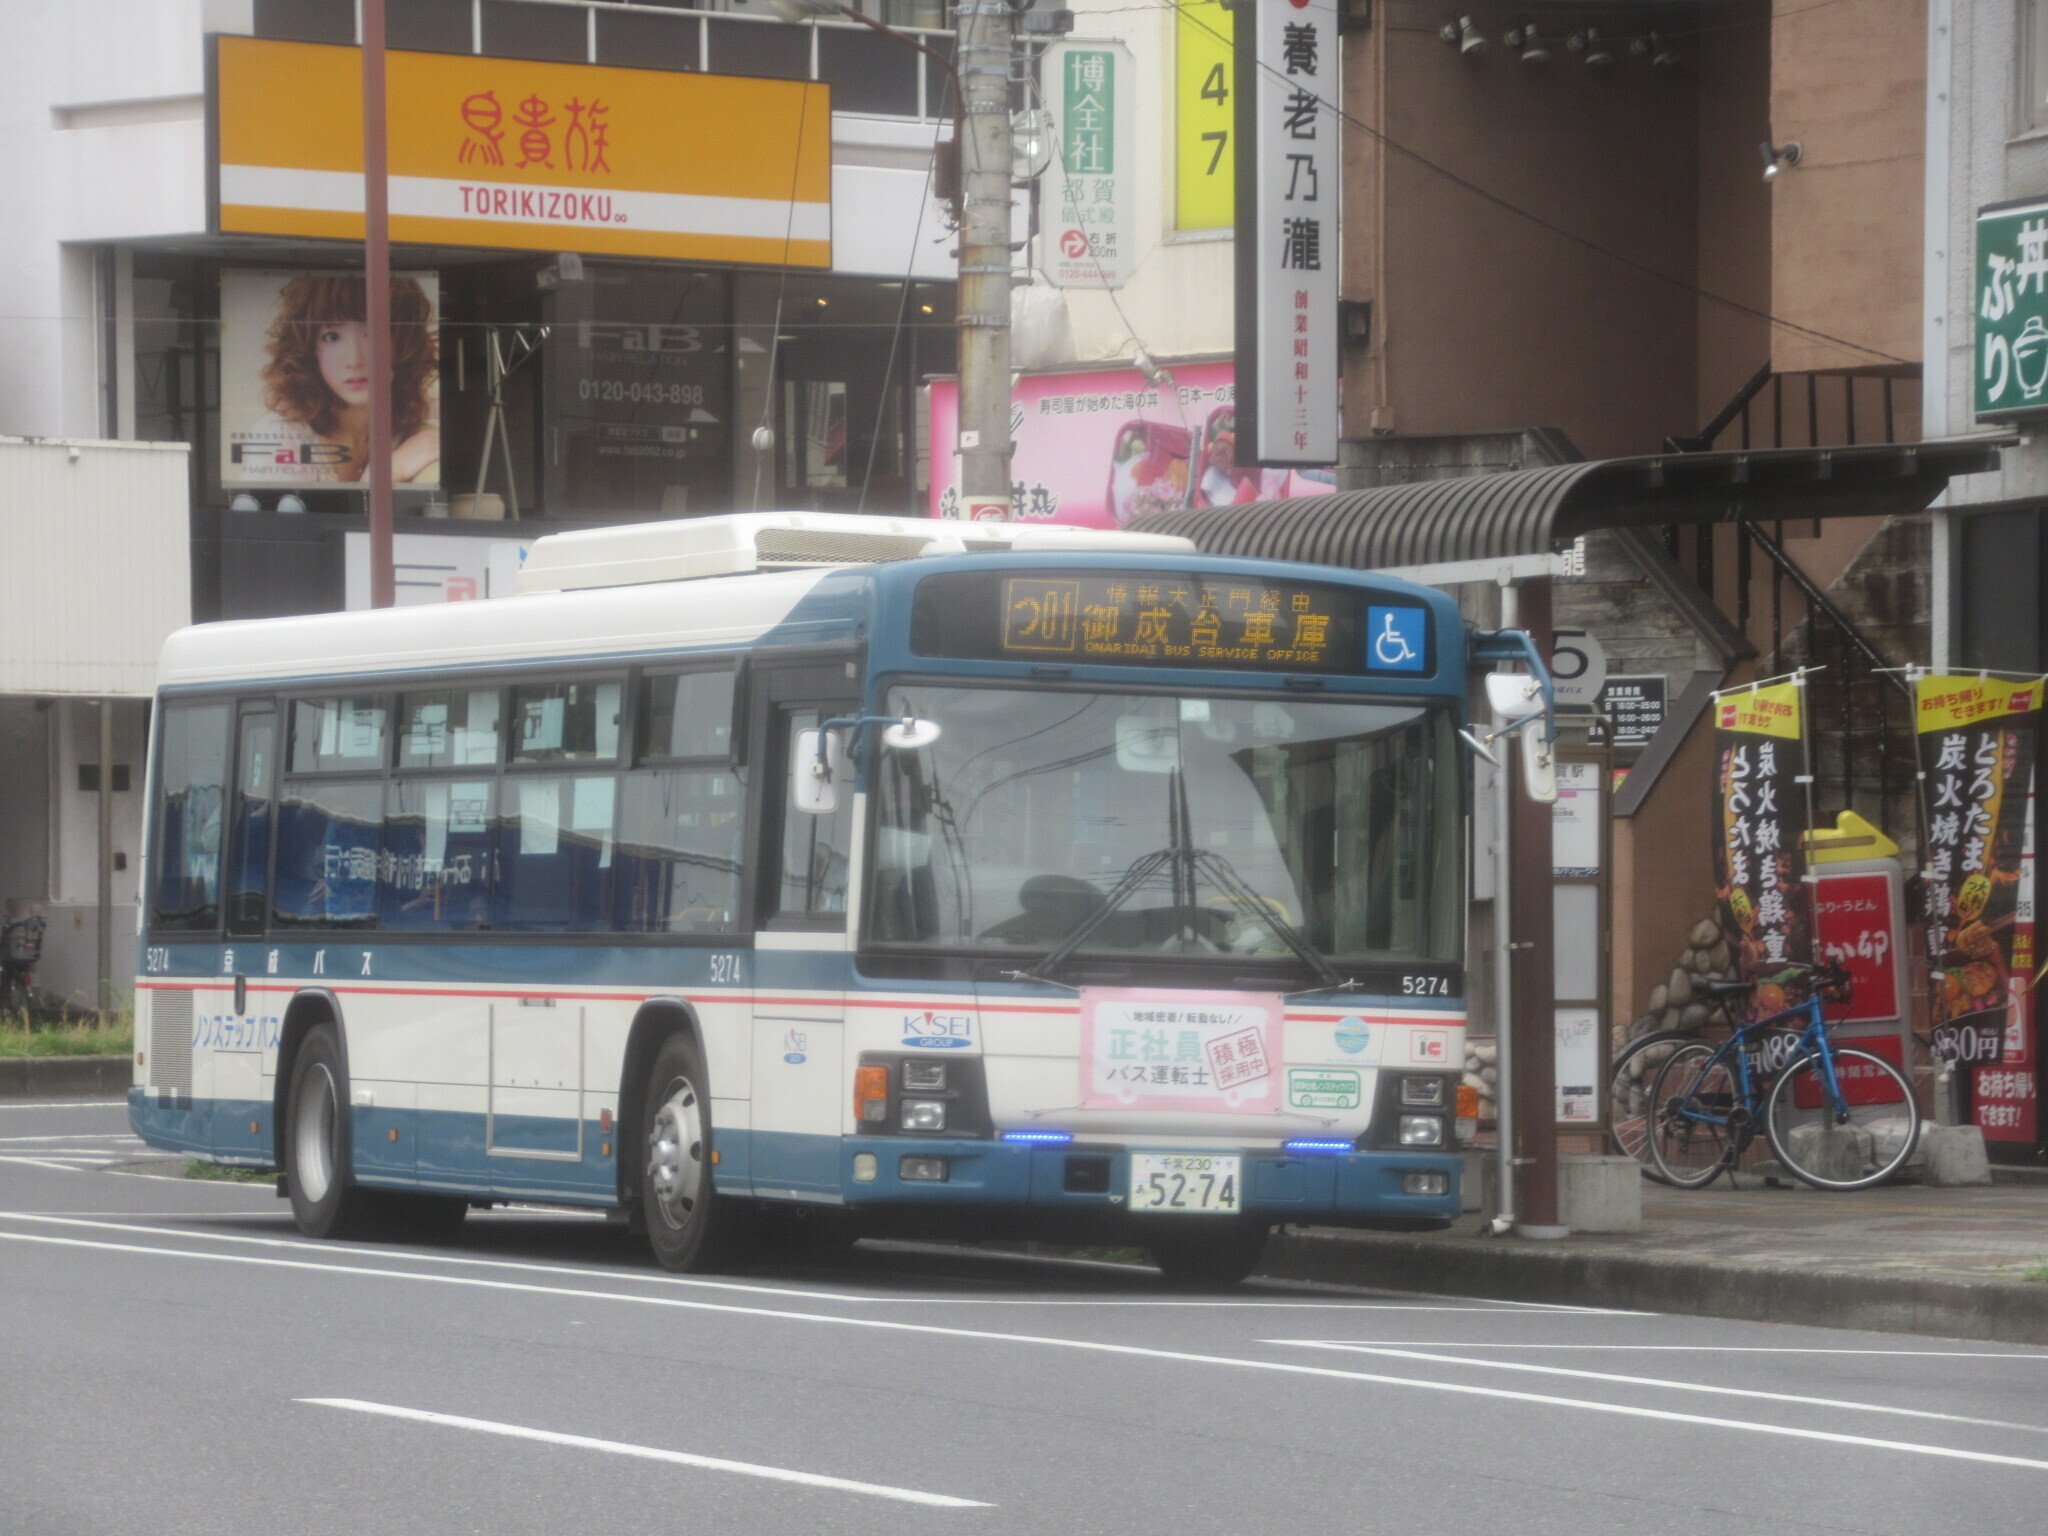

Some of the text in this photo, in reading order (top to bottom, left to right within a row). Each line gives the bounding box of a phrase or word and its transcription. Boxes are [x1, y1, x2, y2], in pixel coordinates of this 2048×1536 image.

[1070, 55, 1106, 171] 博全社
[458, 91, 611, 174] 鳥貴族
[1281, 21, 1322, 271] 養老乃瀧
[459, 186, 611, 222] TORIKIZOKU
[1061, 179, 1115, 204] 都賀
[1089, 232, 1117, 245] 右折
[578, 320, 703, 353] FaB
[1294, 289, 1309, 450] 創業昭和十三年
[578, 378, 704, 405] 0120-043-898
[1040, 393, 1158, 415] 寿司屋が始めた海の丼
[231, 443, 353, 465] FaB
[1082, 603, 1330, 648] 御成台車庫
[1164, 645, 1191, 658] BUS
[1920, 687, 1984, 712] お持ち帰り
[1949, 698, 2004, 720] できます!
[1961, 732, 1998, 872] とろたま
[146, 948, 170, 972] 5274
[223, 949, 373, 976] 京成バス
[1812, 930, 1889, 968] か卯
[710, 954, 741, 983] 5274
[1402, 976, 1449, 996] 5274
[193, 1015, 281, 1048] ノンステップバス
[920, 1038, 953, 1048] GROUP
[1108, 1028, 1202, 1063] 正社員
[1213, 1034, 1260, 1066] 積極
[1107, 1065, 1209, 1085] バス運転士
[1220, 1057, 1264, 1085] 採用中
[1977, 1070, 2037, 1099] お持ち帰り
[1977, 1104, 2023, 1128] できます!
[1149, 1172, 1235, 1208] 52-74
